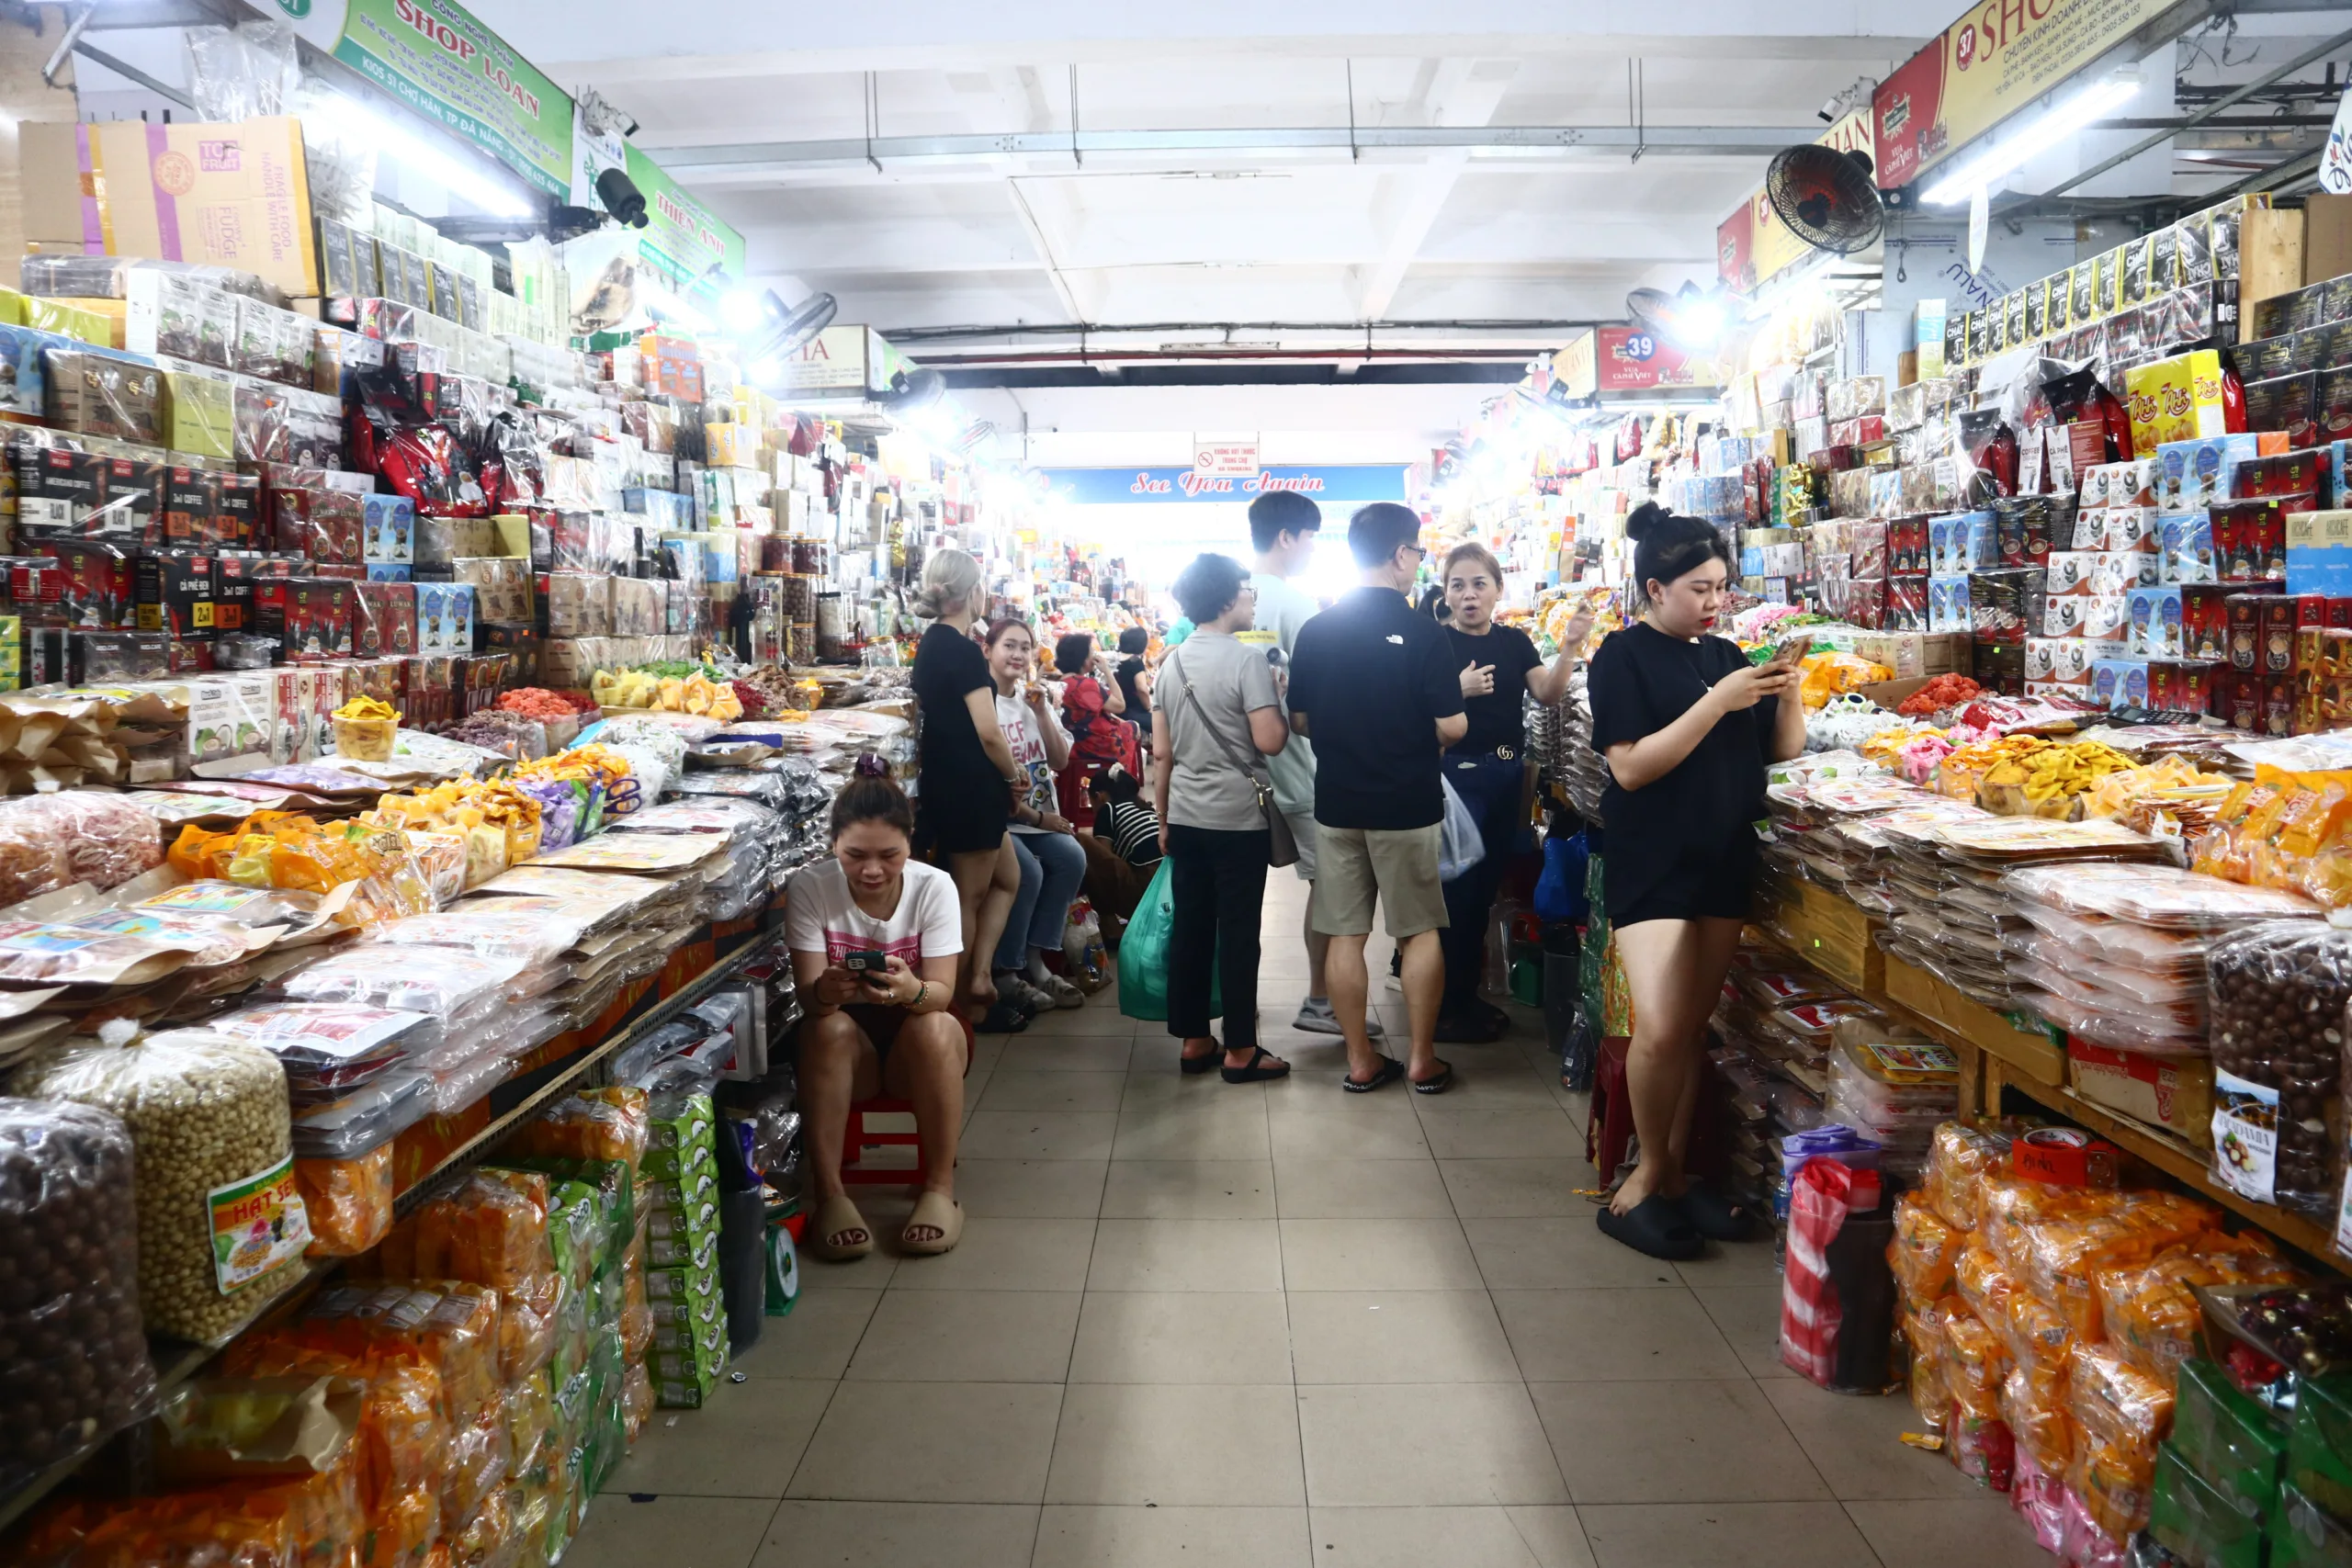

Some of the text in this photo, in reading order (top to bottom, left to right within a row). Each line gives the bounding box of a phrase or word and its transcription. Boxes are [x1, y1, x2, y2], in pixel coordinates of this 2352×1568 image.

[2033, 21, 2051, 42] KINH
[1959, 28, 1973, 57] 37
[396, 0, 476, 62] SHOP
[483, 56, 540, 120] LOAN
[362, 56, 385, 80] KIOS
[387, 73, 397, 88] 51
[446, 110, 458, 124] TP
[261, 152, 284, 264] HANDLE WITH CARE
[279, 216, 292, 248] FOOD
[656, 192, 695, 235] THIỆN
[699, 228, 726, 256] ANH
[219, 207, 237, 260] FUDGE
[1628, 336, 1652, 357] 39
[1623, 367, 1639, 375] VUA
[1214, 447, 1229, 456] KHÔNG
[2021, 446, 2041, 456] COFFEE
[2049, 444, 2068, 455] CÀ PHÊ
[74, 479, 91, 490] COFFEE
[1131, 472, 1171, 494] See
[1178, 472, 1234, 498] You
[184, 493, 203, 505] COFFEE
[232, 498, 248, 509] COFFEE
[50, 503, 65, 520] BLACK
[112, 508, 126, 525] BLACK
[179, 578, 187, 592] CÀ
[187, 578, 199, 592] PHÊ
[194, 702, 213, 712] COCONUT
[213, 700, 229, 710] COFFEE
[252, 696, 268, 705] COFFEE
[232, 1190, 273, 1224] HẠT
[277, 1178, 298, 1203] SE
